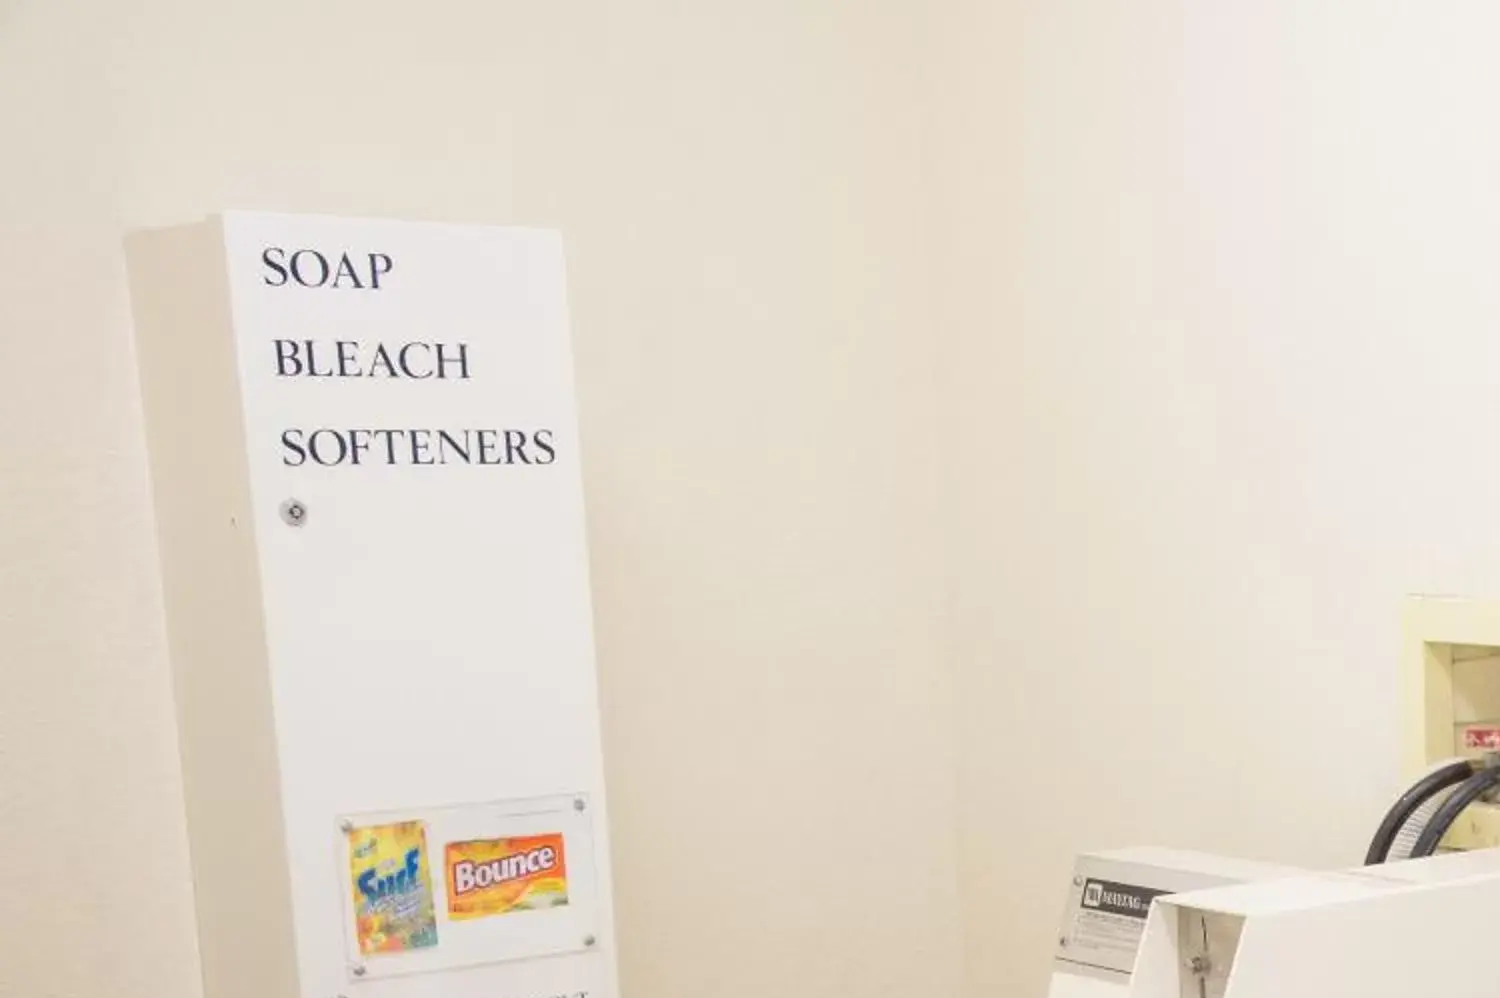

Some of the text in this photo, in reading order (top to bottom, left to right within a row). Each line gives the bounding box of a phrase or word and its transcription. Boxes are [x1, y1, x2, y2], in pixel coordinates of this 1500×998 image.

[261, 247, 393, 289] SOAP
[272, 338, 472, 379] BLEACH
[280, 429, 556, 466] SOFTENERS
[454, 846, 555, 894] Bounce
